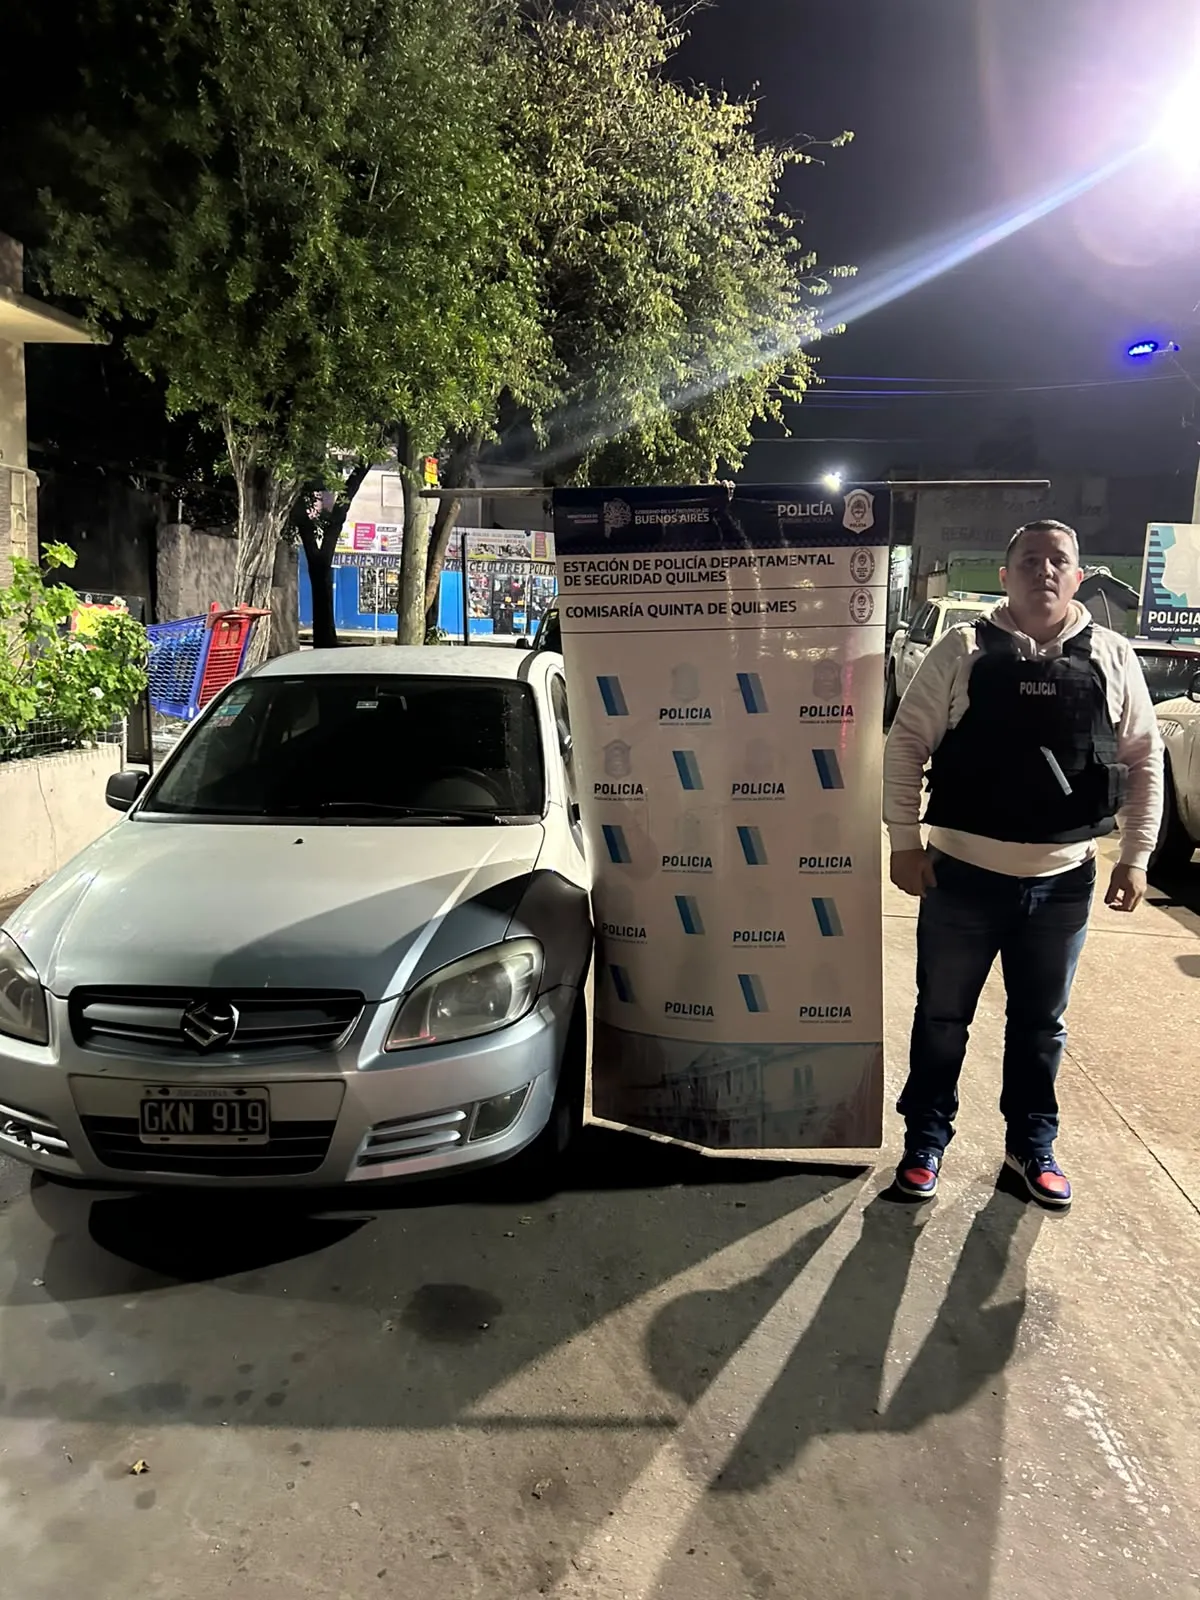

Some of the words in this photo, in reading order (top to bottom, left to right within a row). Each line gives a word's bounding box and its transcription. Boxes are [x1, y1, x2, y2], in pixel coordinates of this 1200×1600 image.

[777, 500, 834, 517] POLICÍA
[634, 514, 677, 525] BUENOS
[679, 513, 710, 523] AIRES
[469, 561, 525, 575] CELULARES
[563, 558, 629, 573] ESTACIÓN
[632, 559, 652, 571] DE
[654, 555, 707, 570] POLICÍA
[710, 554, 835, 569] DEPARTAMENTAL
[564, 575, 582, 586] DE
[584, 572, 662, 586] SEGURIDAD
[665, 570, 727, 585] QUILMES
[565, 602, 644, 618] COMISARÍA
[647, 603, 704, 618] QUINTA
[708, 603, 727, 615] DE
[731, 600, 797, 616] QUILMES
[1148, 611, 1200, 625] POLICIA
[1020, 681, 1057, 696] POLICIA
[659, 707, 712, 720] POLICIA
[799, 704, 854, 717] POLICIA
[594, 783, 644, 795] POLICIA
[731, 782, 785, 795] POLICIA
[661, 855, 713, 868] POLICIA
[799, 856, 852, 868] POLICIA
[602, 922, 647, 938] POLICIA
[732, 930, 786, 942] POLICIA
[664, 1001, 715, 1017] POLICIA
[799, 1006, 852, 1018] POLICIA
[144, 1101, 194, 1132] GKN
[212, 1101, 263, 1132] 919
